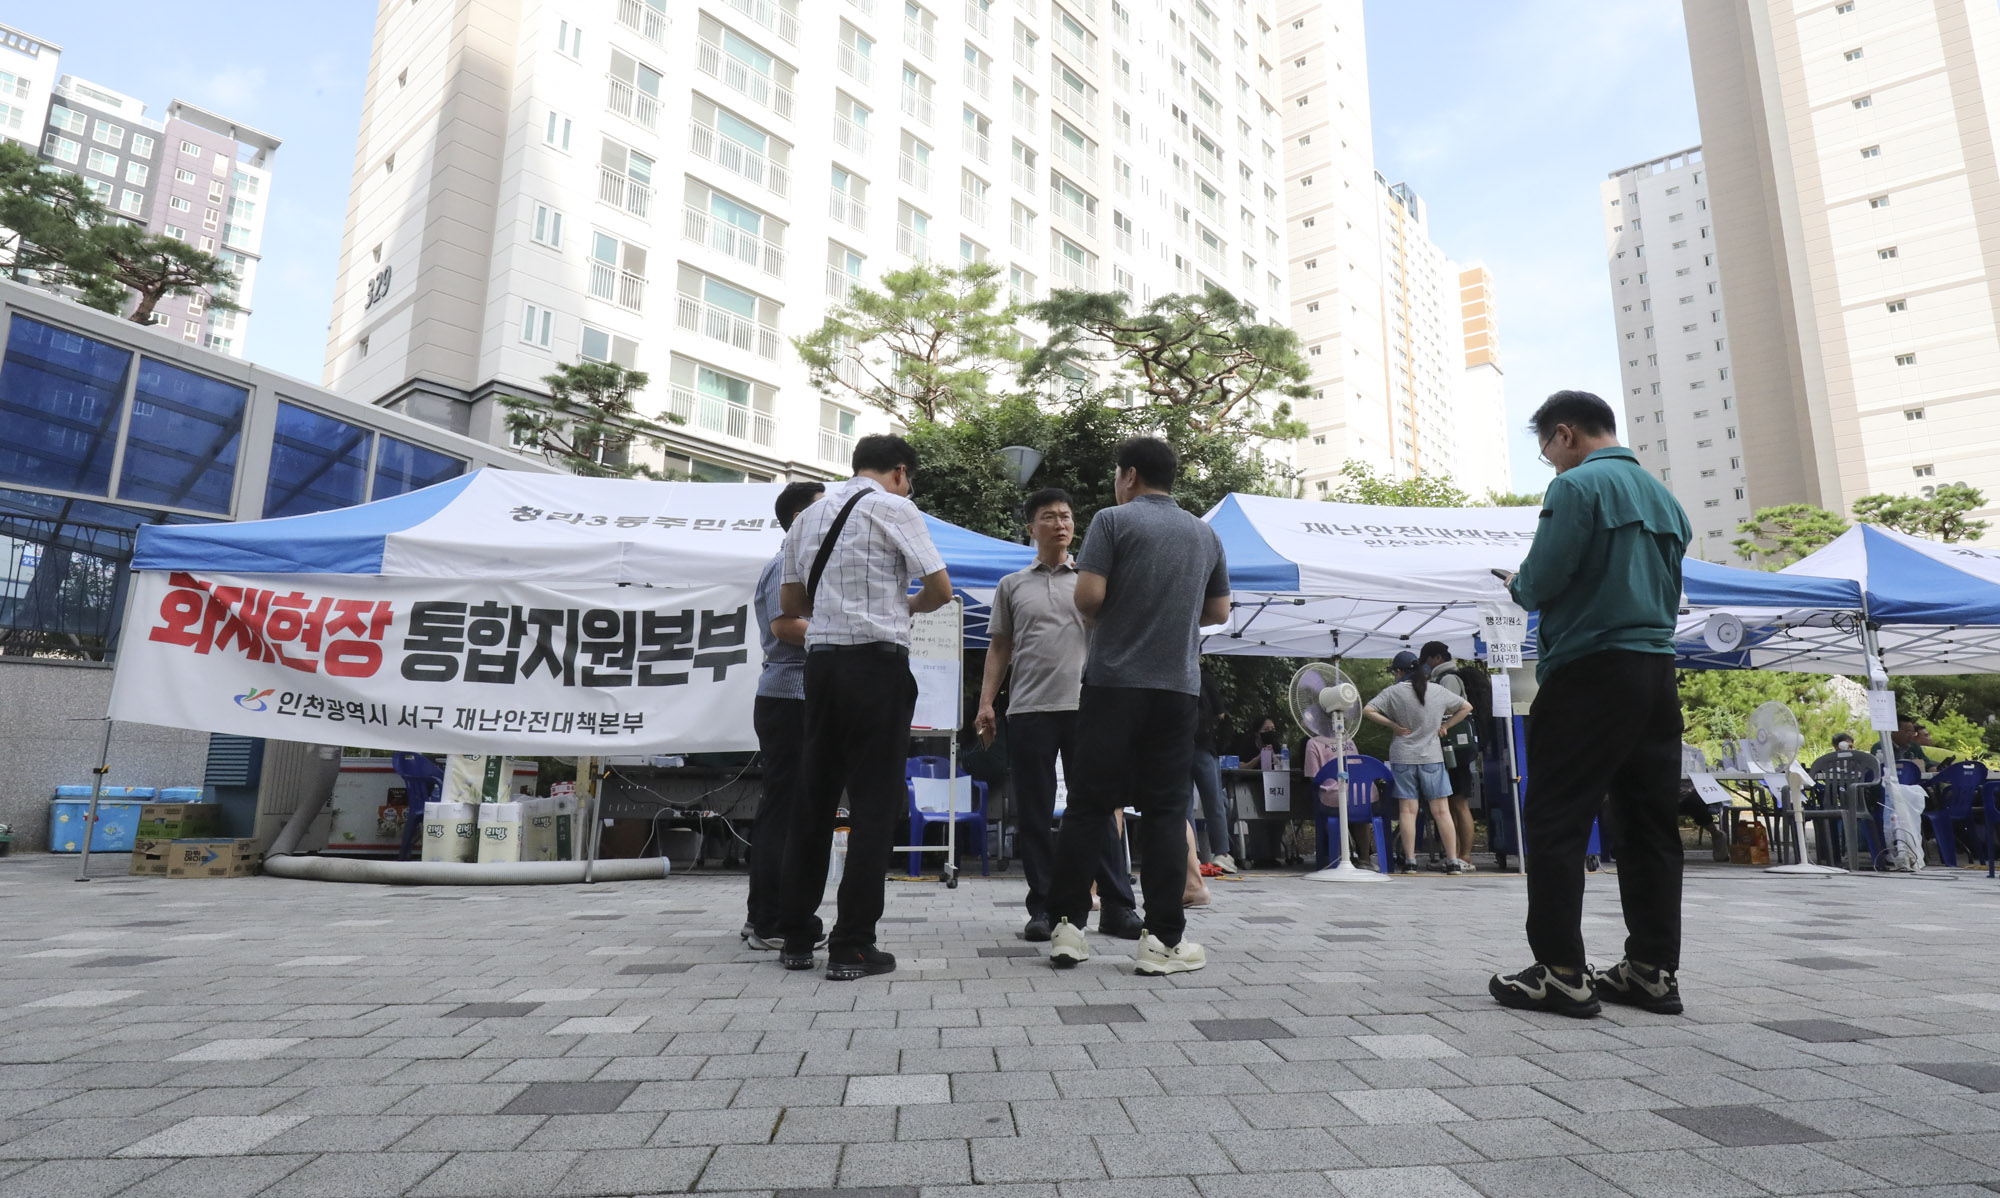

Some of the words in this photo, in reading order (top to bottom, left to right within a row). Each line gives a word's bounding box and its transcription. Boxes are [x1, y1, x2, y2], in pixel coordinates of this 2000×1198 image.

[365, 265, 392, 310] 329
[149, 572, 394, 678] 화재현장
[400, 600, 748, 688] 통합지원본부
[277, 691, 388, 727] 인천광역시
[397, 705, 444, 730] 서구
[453, 707, 644, 735] 재난안전대책본부
[485, 826, 507, 840] 리빙
